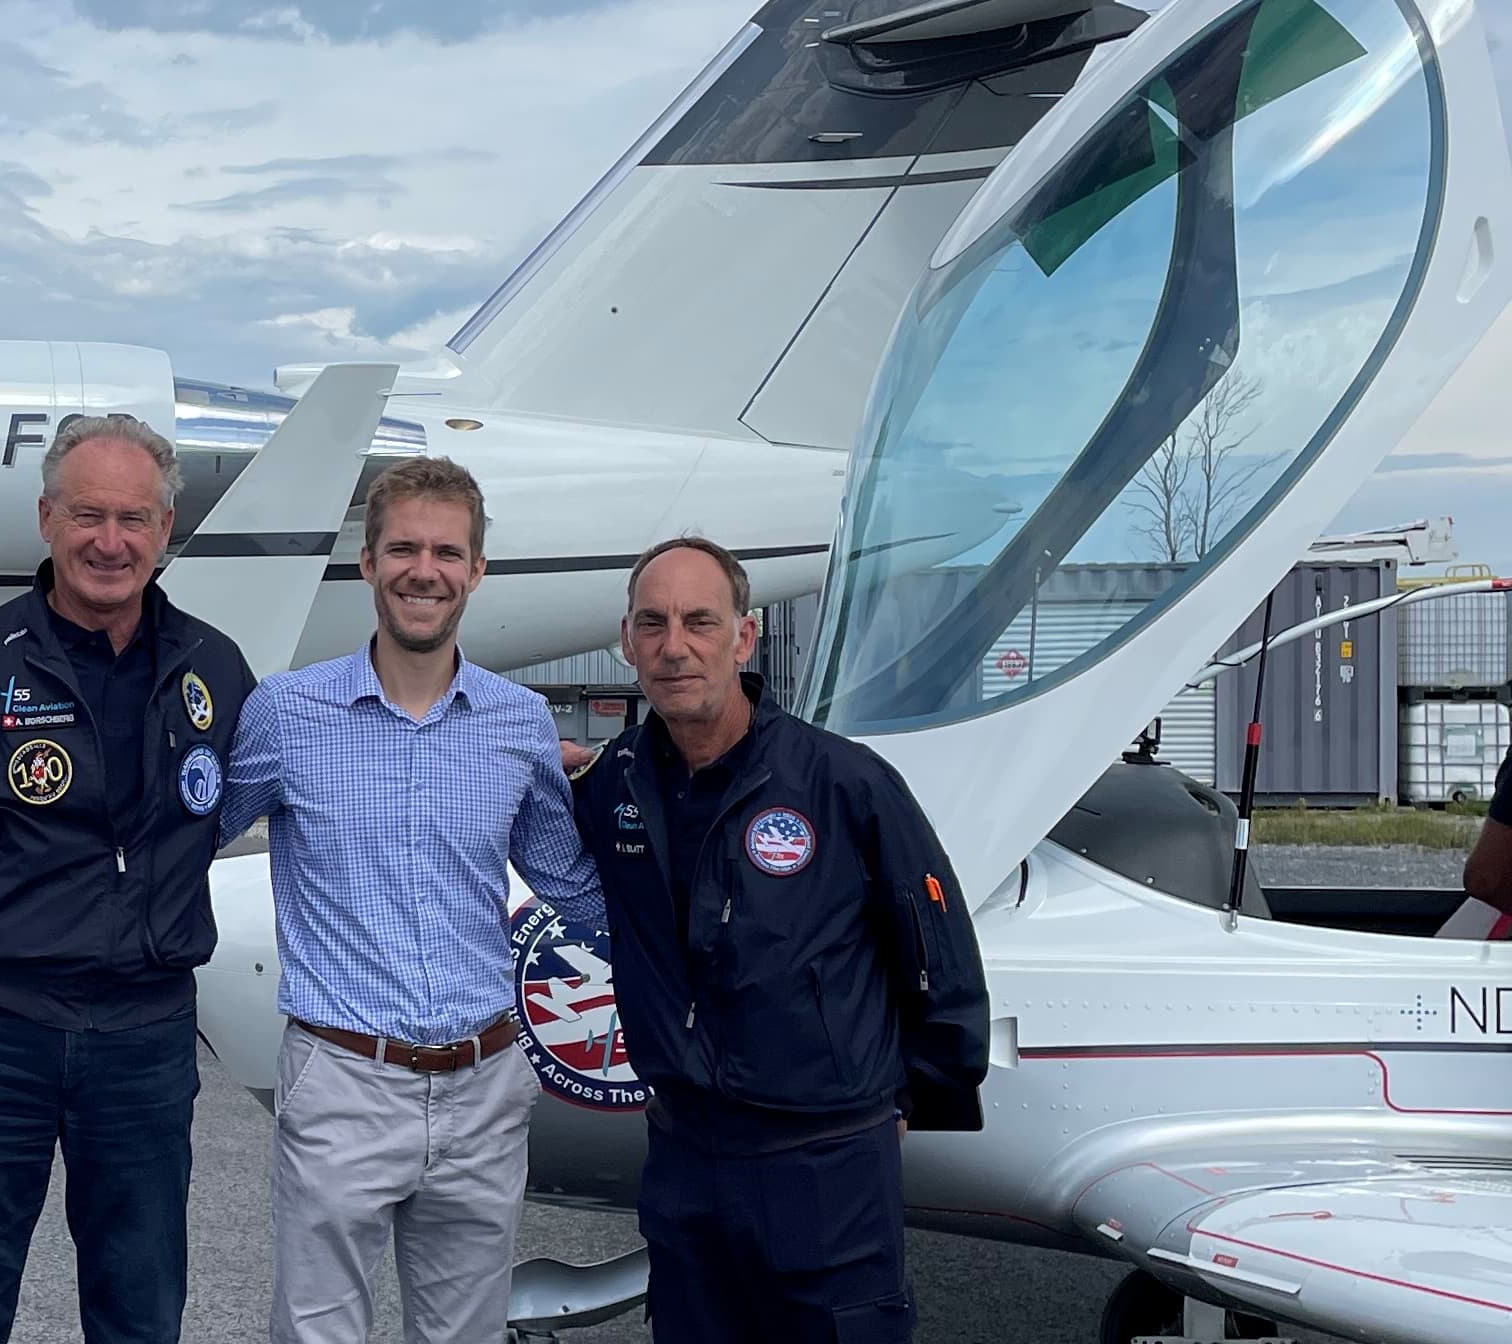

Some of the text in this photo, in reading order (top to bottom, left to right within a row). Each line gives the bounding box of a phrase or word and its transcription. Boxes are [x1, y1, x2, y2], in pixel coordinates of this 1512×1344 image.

[12, 701, 75, 713] Clean Aviation
[541, 1063, 645, 1104] Across The
